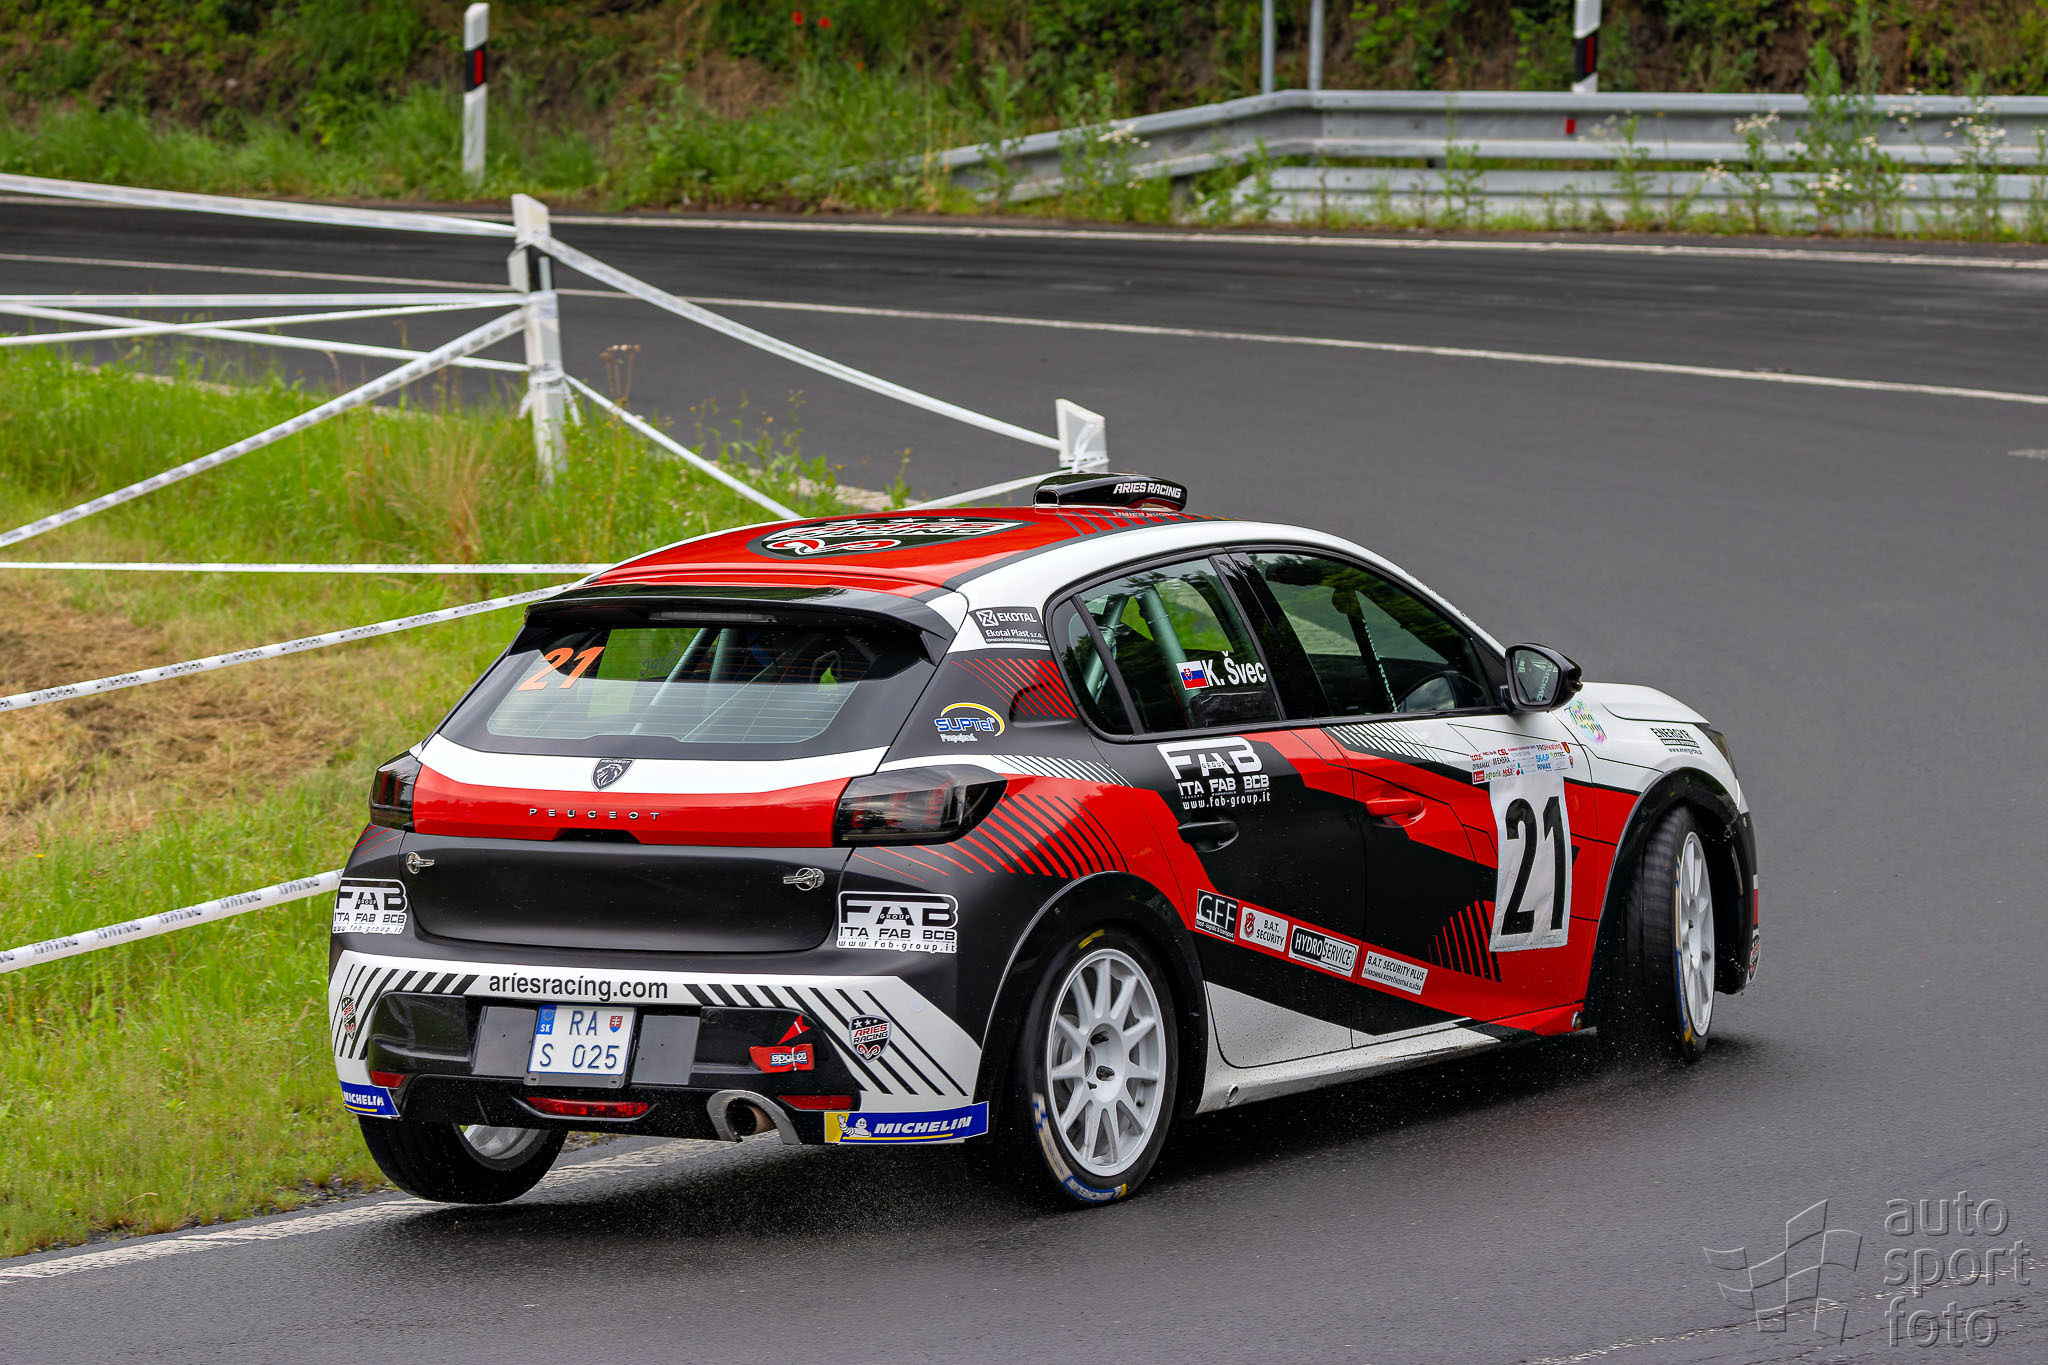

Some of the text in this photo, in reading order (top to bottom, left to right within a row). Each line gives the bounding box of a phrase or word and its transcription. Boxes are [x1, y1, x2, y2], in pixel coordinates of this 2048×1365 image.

[1113, 482, 1182, 498] ARIES RACING
[997, 612, 1038, 623] EKOTAL
[985, 629, 1010, 637] Ekotal
[1012, 629, 1030, 637] Plast
[517, 646, 605, 692] 21
[1201, 650, 1267, 686] K. Švec
[1156, 736, 1262, 780] FAB
[1178, 781, 1204, 795] ITA
[1209, 778, 1236, 792] FAB
[1243, 774, 1269, 789] BCB
[1182, 792, 1271, 810] www.fab-group.it
[529, 808, 660, 820] PEUGEOT
[1501, 796, 1566, 936] 21
[336, 880, 404, 910] FAB
[334, 912, 405, 924] ITA FAB BCB
[841, 894, 956, 928] FAB
[334, 925, 402, 933] www.fab-group.it
[840, 927, 869, 937] ITA
[878, 928, 911, 939] FAB
[922, 930, 956, 940] BCB
[1264, 920, 1279, 932] B.A.T.
[1256, 929, 1285, 945] SECURITY
[838, 940, 956, 952] www.fab-group.it
[1295, 933, 1352, 966] HYDROSERVICE
[1367, 956, 1382, 968] B.A.T.
[1383, 960, 1411, 976] SECURITY
[1410, 968, 1425, 981] PLUS
[488, 972, 668, 1002] ariesracing.com
[540, 1024, 551, 1032] SK
[569, 1010, 598, 1036] RA
[854, 1024, 888, 1037] ARIES
[853, 1031, 888, 1043] RACING
[539, 1043, 620, 1070] S 025
[343, 1091, 384, 1106] MICHELIN
[874, 1115, 972, 1136] MICHELIN
